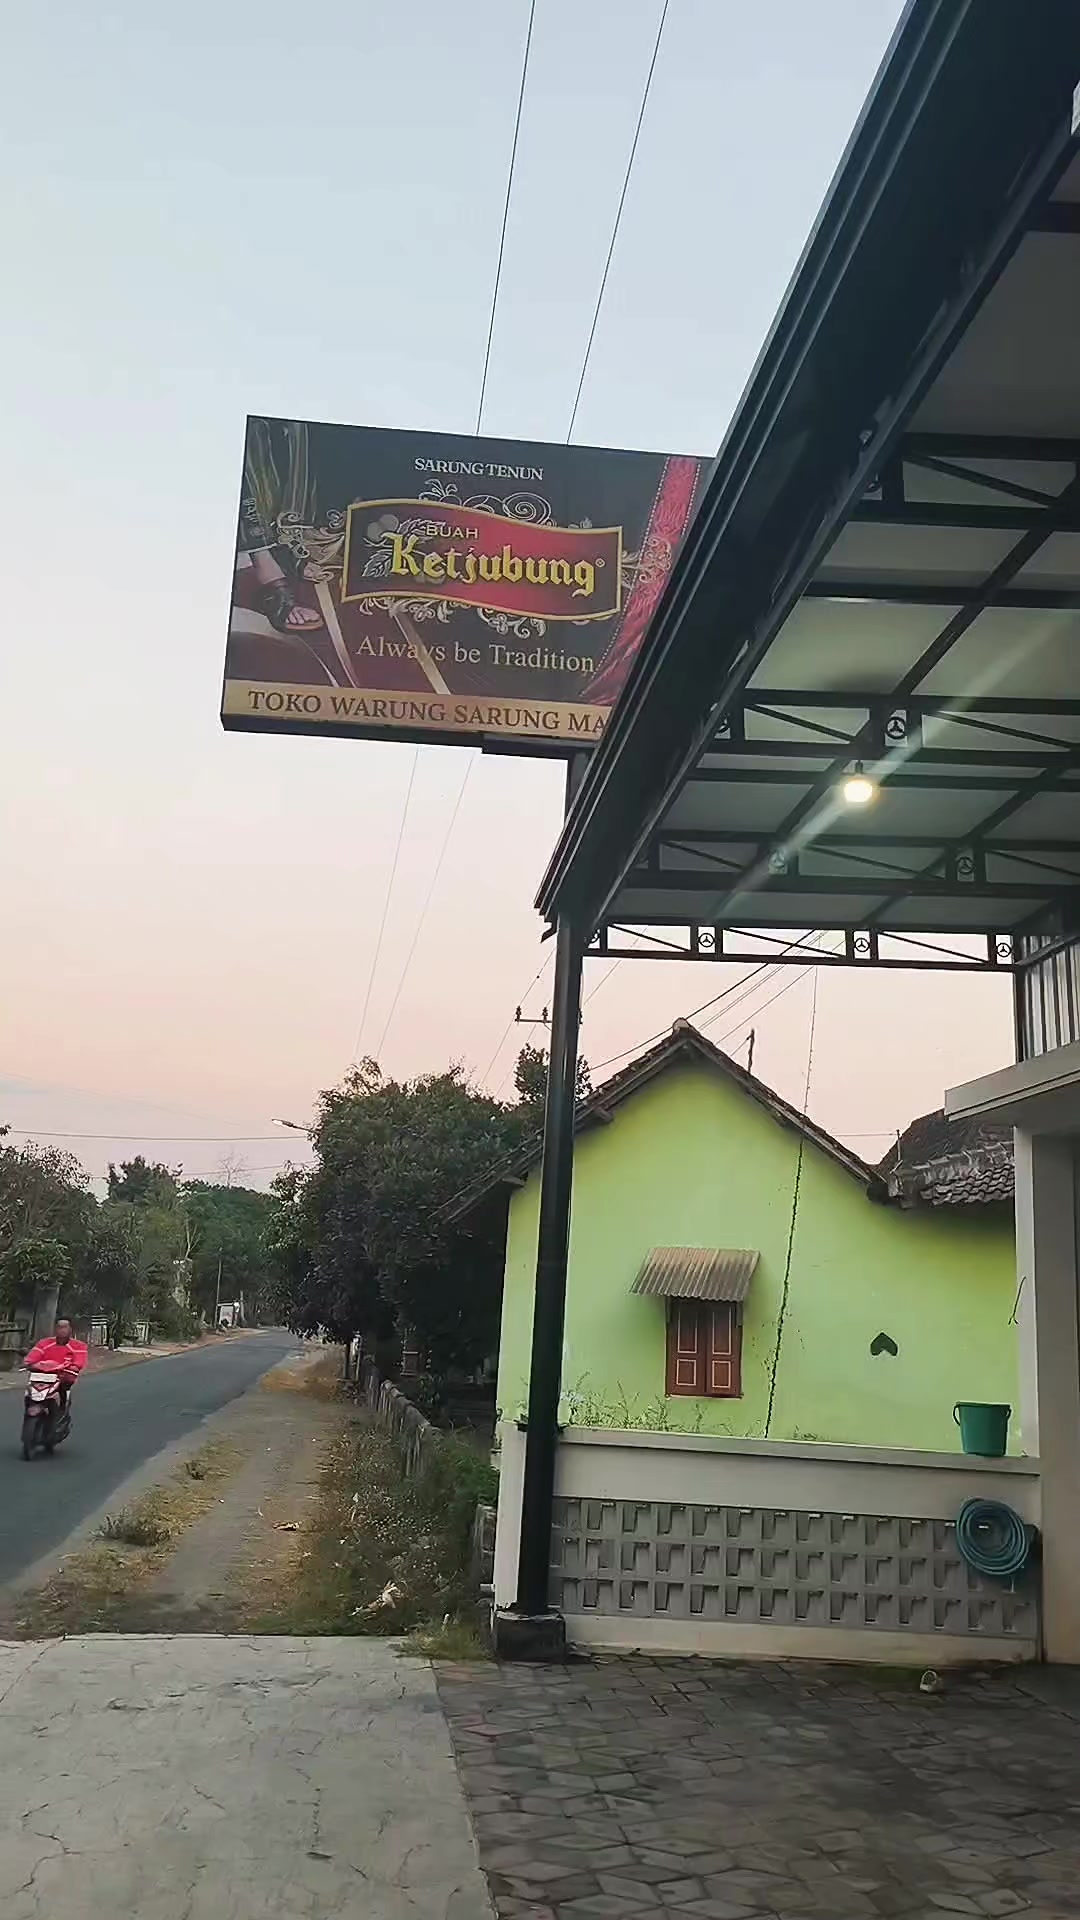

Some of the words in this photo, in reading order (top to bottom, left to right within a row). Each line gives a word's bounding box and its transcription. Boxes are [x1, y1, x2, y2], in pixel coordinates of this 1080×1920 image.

[414, 457, 484, 475] SARUNG
[485, 463, 544, 480] TENUN
[426, 524, 479, 539] BUAH
[381, 531, 595, 598] Ketjubung
[455, 641, 481, 663] be
[489, 643, 596, 673] Tradition
[248, 690, 321, 713] TOKO
[330, 696, 447, 721] WARUNG
[454, 704, 560, 730] SARUNG
